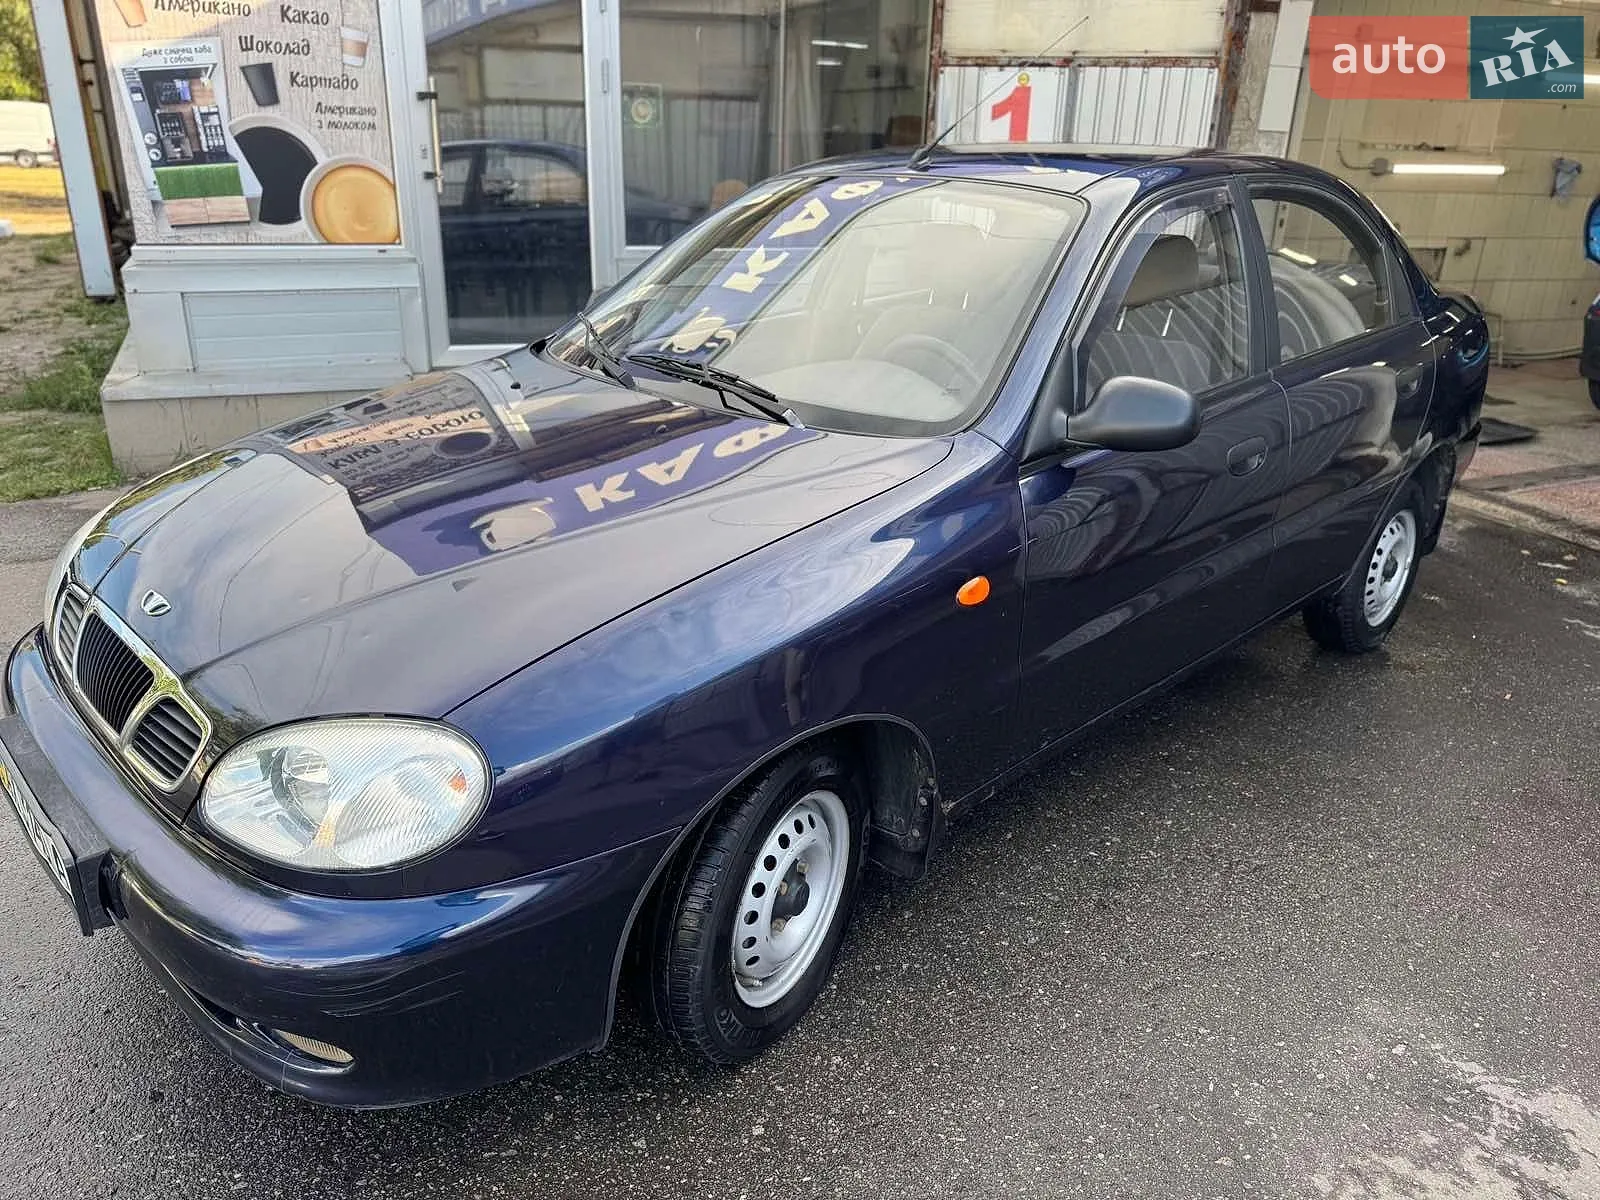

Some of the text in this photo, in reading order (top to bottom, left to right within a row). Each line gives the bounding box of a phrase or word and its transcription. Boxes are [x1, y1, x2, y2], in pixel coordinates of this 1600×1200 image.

[154, 0, 251, 17] Американо
[280, 4, 329, 25] Какао
[238, 35, 311, 56] Шоколад
[290, 71, 359, 92] Картадо
[315, 101, 377, 118] Американо
[991, 86, 1031, 143] 1
[327, 120, 377, 130] молоком
